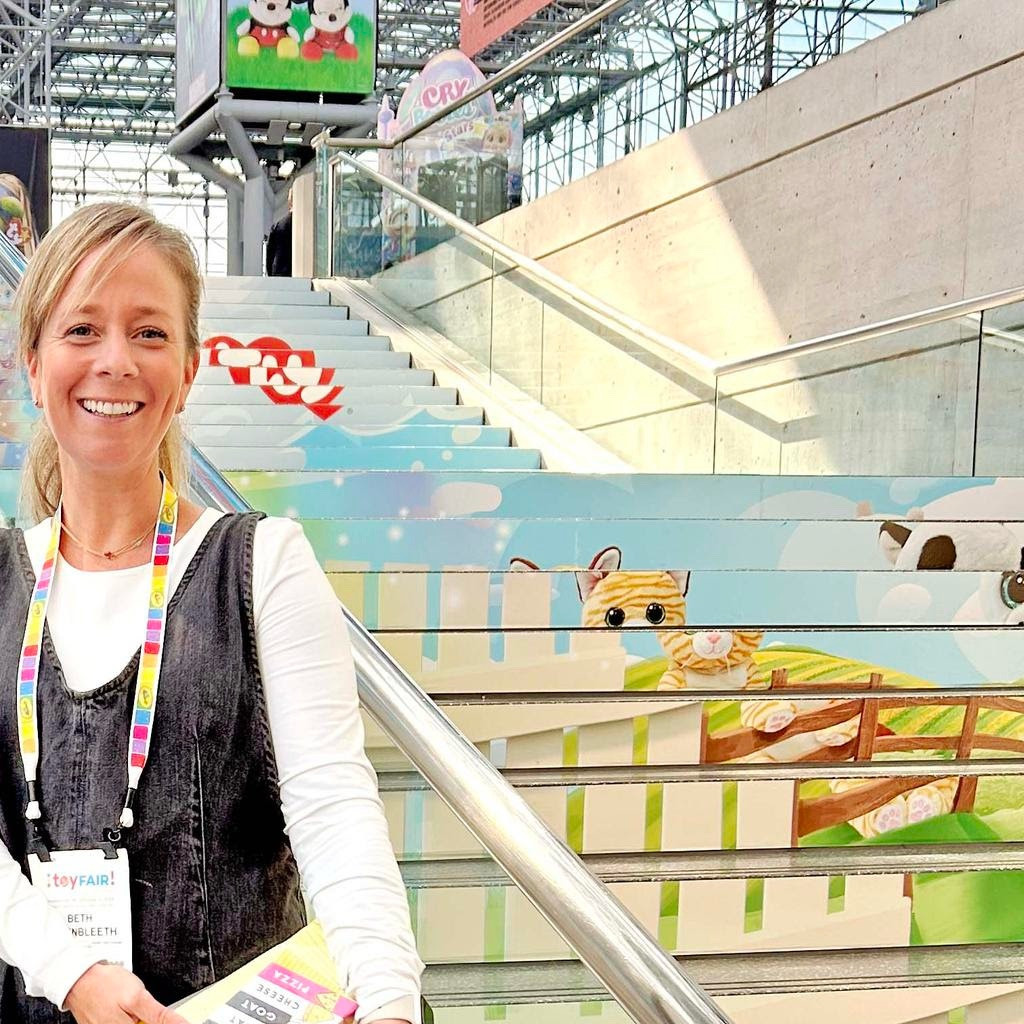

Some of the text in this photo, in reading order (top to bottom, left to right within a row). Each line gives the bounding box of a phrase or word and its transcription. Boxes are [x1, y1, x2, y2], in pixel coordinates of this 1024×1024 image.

[422, 79, 469, 109] CRY
[215, 341, 335, 404] ty
[67, 914, 93, 923] BETH
[71, 927, 118, 937] NBLEETH
[274, 969, 311, 994] PIZZA
[256, 983, 300, 1010] CHEESE
[240, 999, 276, 1021] GOAT
